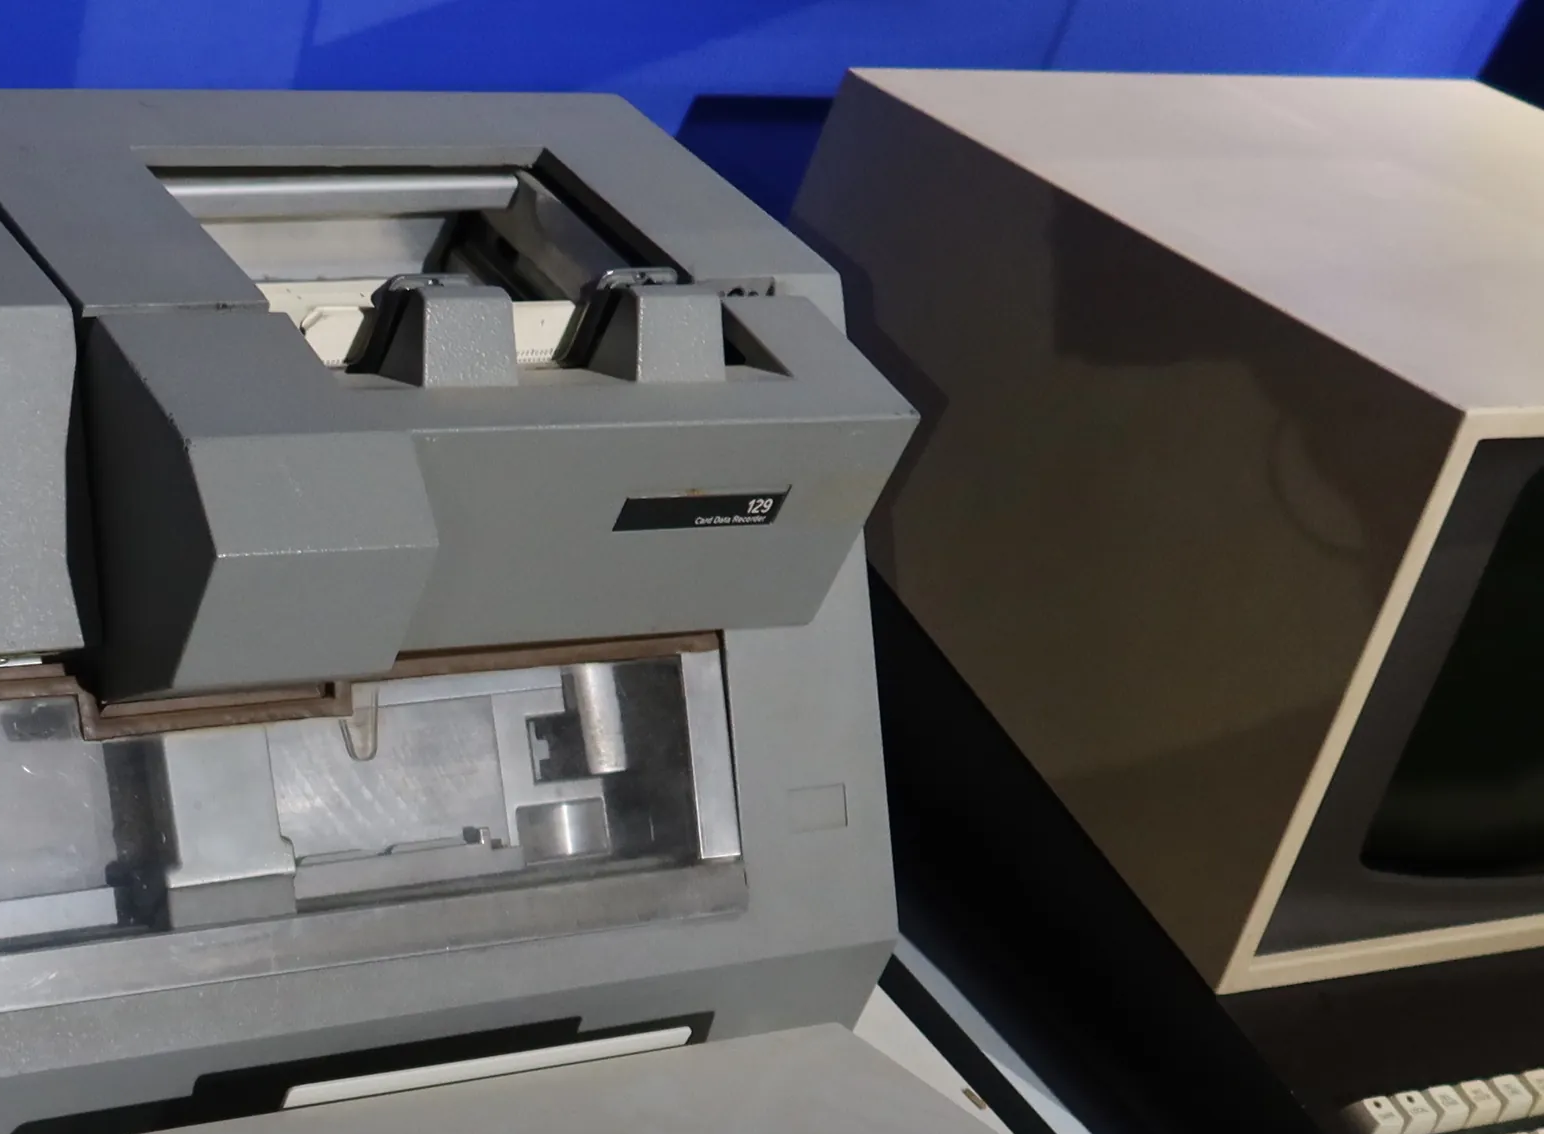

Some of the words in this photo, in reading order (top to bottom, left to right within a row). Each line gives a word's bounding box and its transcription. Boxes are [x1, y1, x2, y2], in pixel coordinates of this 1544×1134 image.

[746, 498, 774, 514] 129
[694, 515, 714, 525] Card
[713, 515, 732, 525] Data
[732, 514, 767, 524] Recorder
